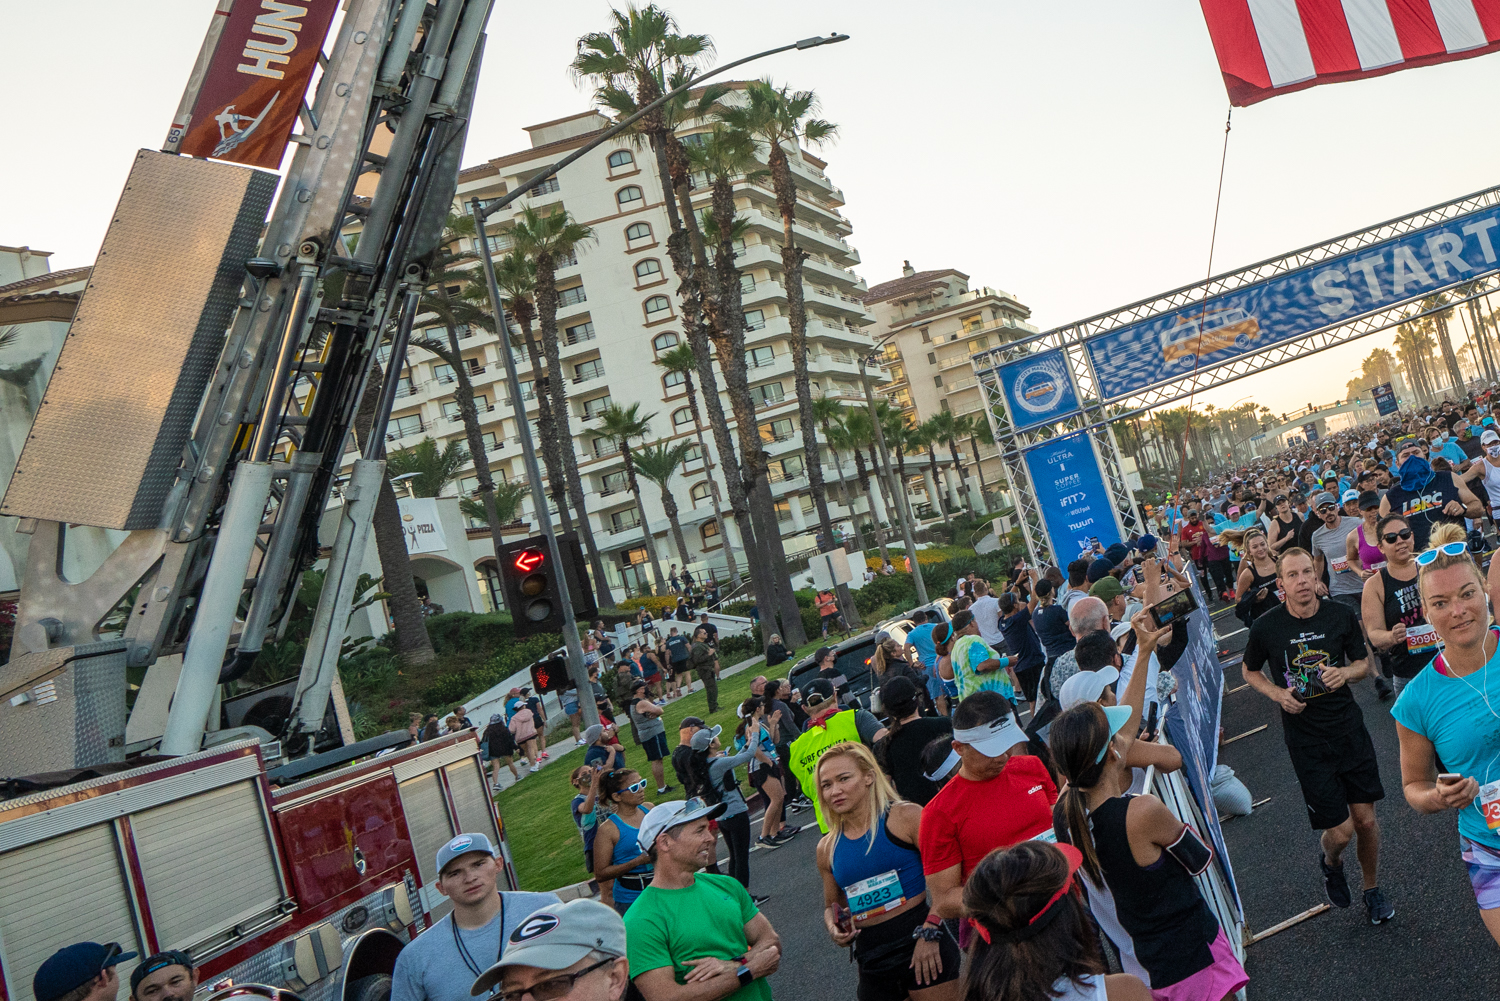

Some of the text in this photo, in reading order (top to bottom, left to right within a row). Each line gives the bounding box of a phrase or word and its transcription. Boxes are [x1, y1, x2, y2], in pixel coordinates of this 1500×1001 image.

[1311, 216, 1499, 317] START
[1047, 451, 1074, 465] ULTRA
[1054, 473, 1079, 486] SUPER
[1060, 494, 1079, 507] iFIT
[1402, 491, 1443, 516] LBRC
[417, 523, 436, 534] PIZZA
[1068, 517, 1094, 531] nuun
[800, 752, 816, 768] SURF
[816, 743, 832, 758] CITY
[1027, 784, 1043, 795] adidas
[857, 887, 892, 907] 4923
